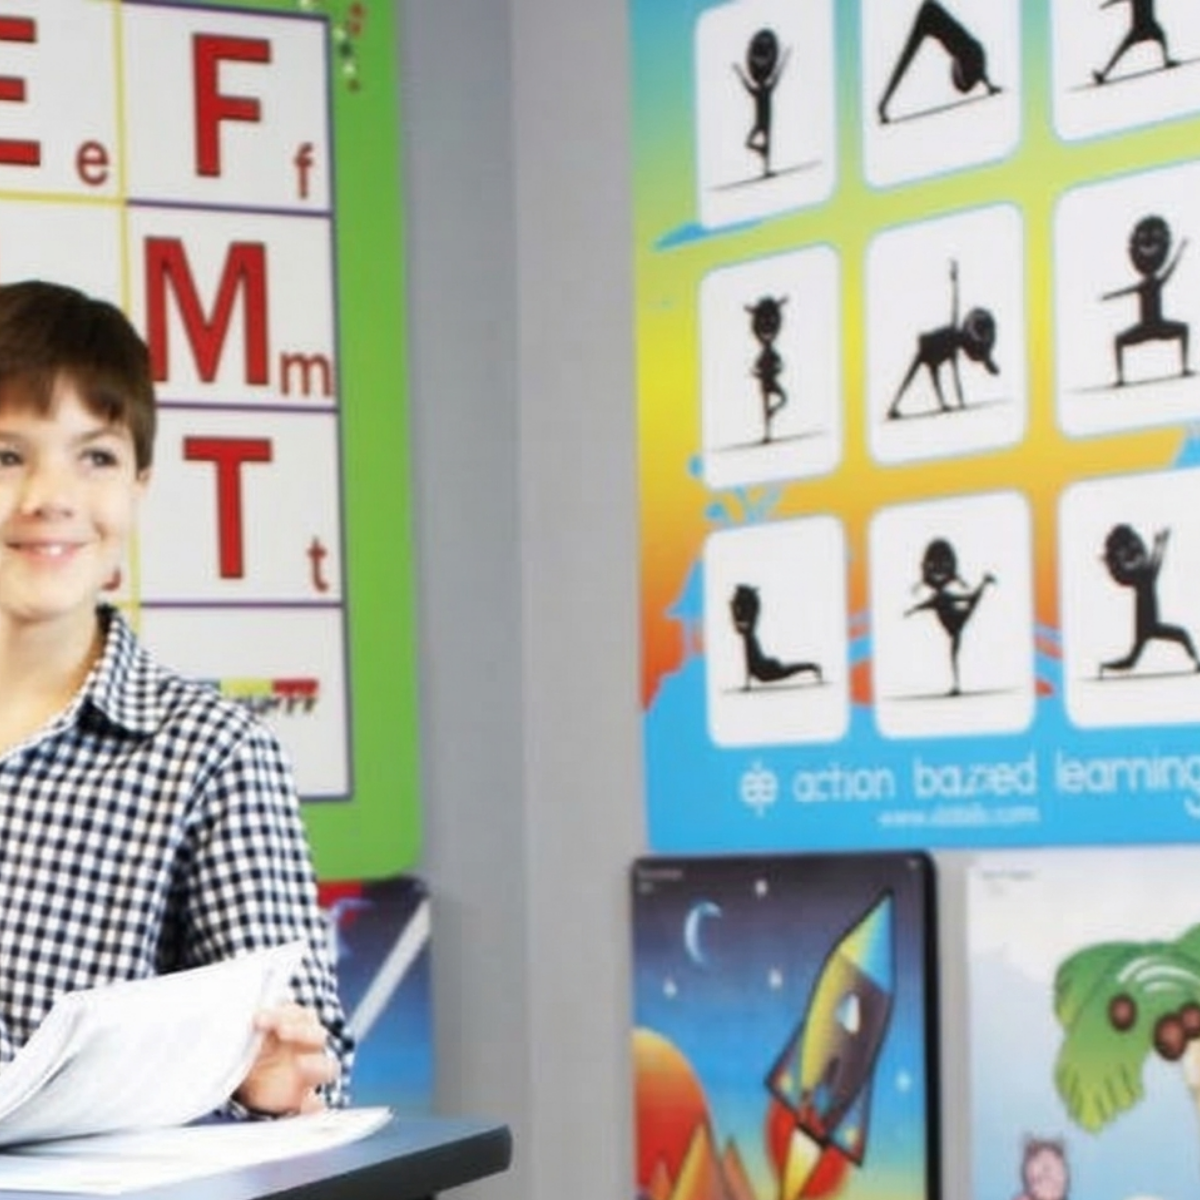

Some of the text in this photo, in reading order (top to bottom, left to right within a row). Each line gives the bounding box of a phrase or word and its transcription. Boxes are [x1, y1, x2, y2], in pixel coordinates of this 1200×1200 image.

[76, 141, 109, 186] e
[191, 32, 272, 177] F
[294, 142, 313, 199] f
[143, 236, 271, 386] M
[280, 353, 333, 397] m
[182, 435, 274, 580] T
[308, 540, 328, 592] t
[793, 763, 896, 802] action
